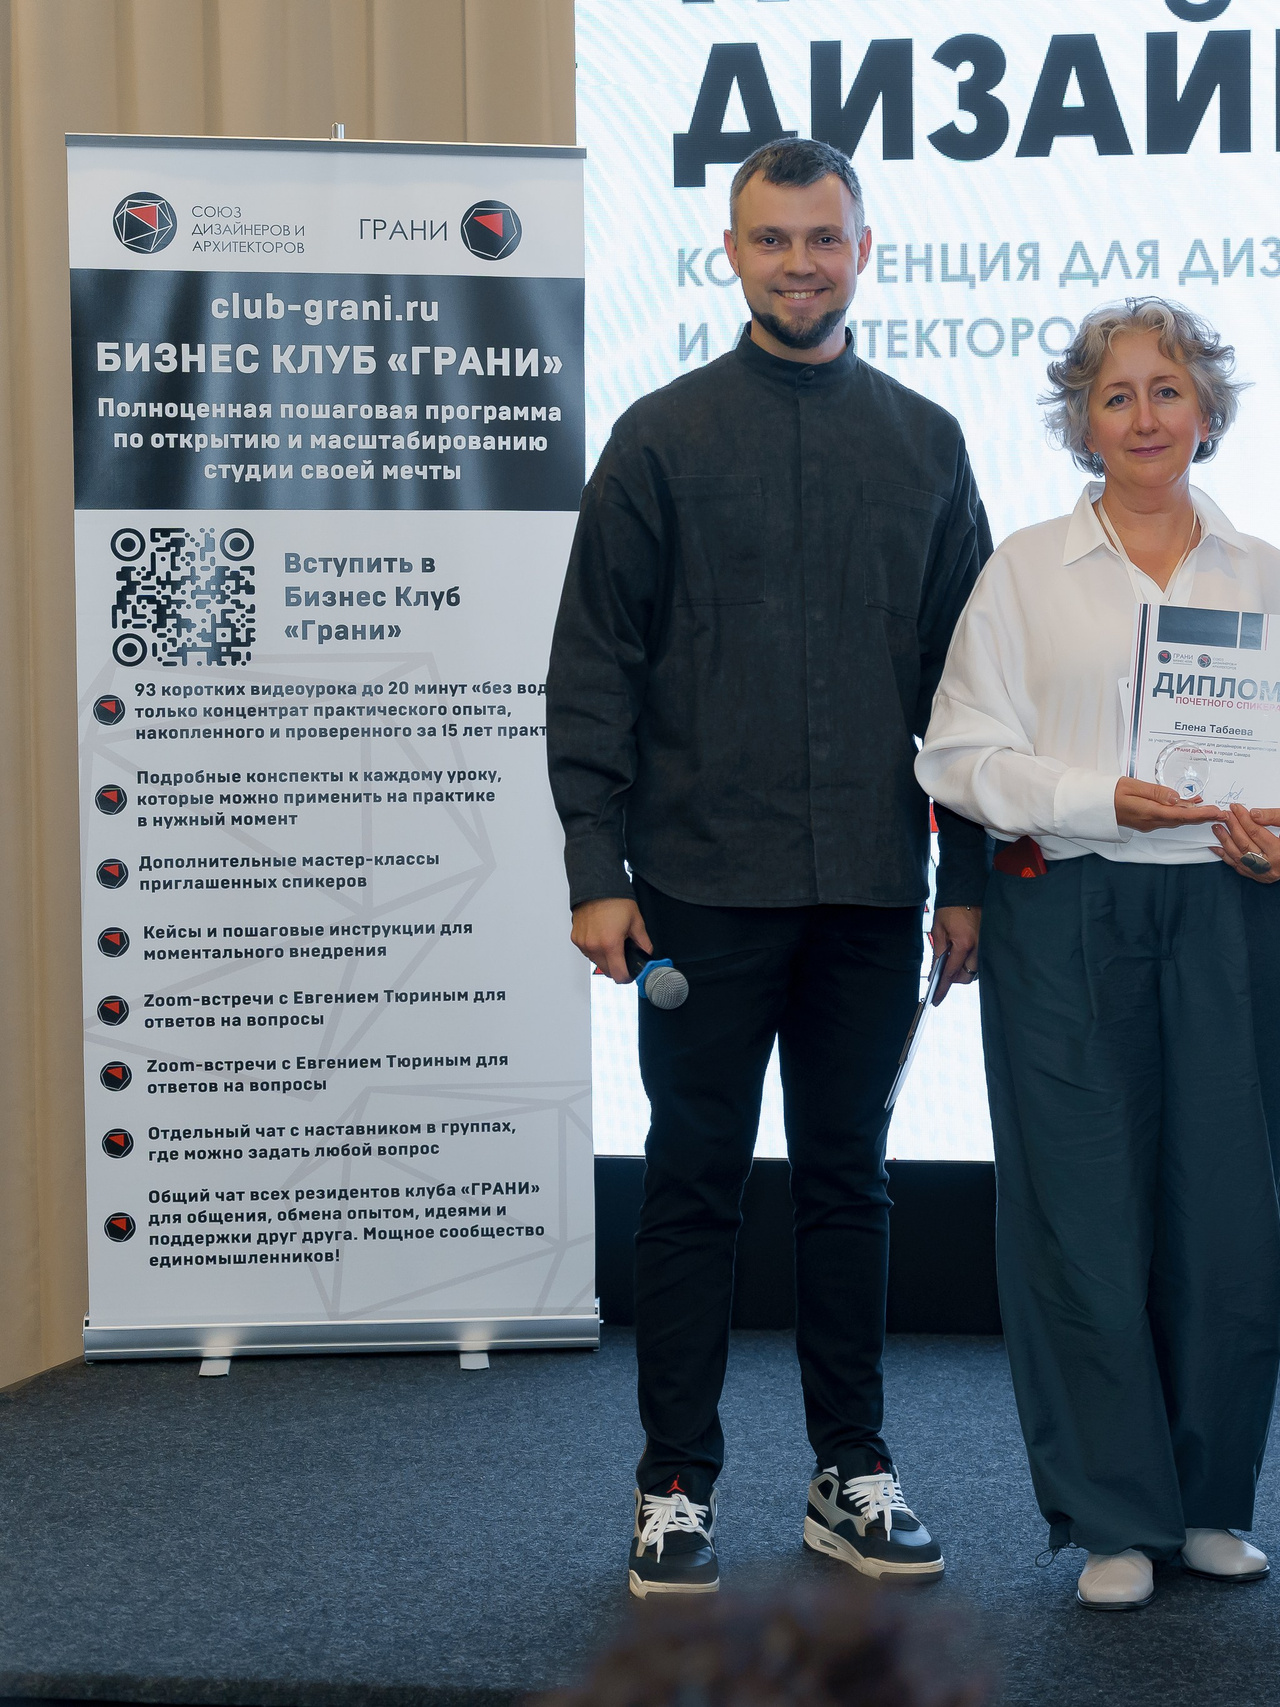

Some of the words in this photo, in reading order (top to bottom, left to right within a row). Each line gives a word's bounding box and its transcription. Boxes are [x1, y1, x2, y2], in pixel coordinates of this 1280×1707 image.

[192, 206, 241, 218] СОЮЗ
[192, 222, 290, 236] ДИЗАЙНЕРОВ
[295, 225, 304, 236] И
[360, 219, 447, 241] ГРАНИ
[192, 241, 304, 253] АРХИТЕКТОРОВ
[677, 241, 1042, 292] КОЕНЦИЯ
[1059, 237, 1158, 287] ДЛЯ
[211, 293, 439, 325] club-grani.ru
[679, 323, 710, 361] И
[97, 342, 259, 373] БИЗНЕС
[273, 345, 376, 374] КЛУБ
[388, 347, 562, 377] «ГРАНИ»
[98, 398, 272, 421] Полноценная
[281, 403, 417, 424] пошаговая
[426, 405, 561, 424] программа
[114, 433, 143, 448] по
[151, 432, 280, 453] открытию
[288, 434, 301, 448] и
[311, 431, 547, 453] масштабированию
[204, 462, 294, 482] студии
[302, 460, 374, 479] своей
[383, 465, 460, 480] мечты
[285, 553, 413, 577] Вступить
[422, 558, 435, 573] в
[285, 587, 386, 607] Бизнес
[396, 586, 460, 611] Клуб
[285, 620, 401, 644] «Грани»
[135, 683, 156, 696] 93
[162, 686, 245, 698] коротких
[251, 685, 356, 698] видеоурока
[362, 684, 383, 697] до
[389, 681, 408, 694] 20
[415, 684, 467, 697] минут
[472, 681, 512, 694] «без
[517, 683, 546, 698] вод
[1176, 696, 1234, 708] ПОЧЕТНОГО
[135, 707, 197, 718] только
[203, 706, 308, 719] концентрат
[314, 705, 447, 719] практического
[452, 705, 511, 717] опыта,
[136, 728, 264, 739] накопленного
[270, 728, 280, 738] и
[286, 727, 411, 740] проверенного
[417, 727, 436, 737] за
[442, 724, 457, 736] 15
[463, 727, 492, 736] лет
[497, 725, 546, 742] практ
[1174, 722, 1206, 732] Елена
[1210, 724, 1253, 736] Табаева
[137, 770, 241, 786] Подробные
[247, 772, 343, 782] конспекты
[349, 772, 358, 781] к
[364, 771, 443, 783] каждому
[447, 771, 501, 783] уроку,
[138, 794, 214, 807] которые
[220, 794, 278, 804] можно
[284, 793, 382, 806] применить
[387, 792, 407, 802] на
[413, 792, 495, 804] практике
[138, 817, 147, 827] в
[153, 812, 225, 829] нужный
[231, 815, 297, 825] момент
[139, 856, 296, 871] Дополнительные
[303, 855, 439, 868] мастер-классы
[140, 878, 277, 893] приглашенных
[282, 877, 367, 890] спикеров
[144, 925, 201, 939] Кейсы
[207, 928, 217, 937] и
[223, 926, 324, 937] пошаговые
[330, 924, 435, 938] инструкции
[440, 924, 472, 936] для
[144, 948, 284, 960] моментального
[290, 946, 386, 959] внедрения
[144, 994, 273, 1008] Zoom-встречи
[279, 995, 288, 1004] с
[294, 991, 378, 1004] Евгением
[384, 990, 468, 1005] Тюриным
[474, 991, 505, 1003] для
[145, 1017, 215, 1028] ответов
[221, 1017, 241, 1026] на
[247, 1015, 323, 1028] вопросы
[147, 1060, 276, 1073] Zoom-встречи
[282, 1060, 291, 1070] с
[297, 1057, 381, 1069] Евгением
[386, 1055, 470, 1070] Тюриным
[476, 1056, 508, 1068] для
[148, 1083, 218, 1094] ответов
[224, 1082, 244, 1092] на
[250, 1080, 326, 1093] вопросы
[149, 1124, 250, 1141] Отдельный
[256, 1127, 285, 1137] чат
[290, 1127, 299, 1136] с
[305, 1124, 421, 1136] наставником
[427, 1124, 436, 1133] в
[442, 1122, 515, 1135] группах,
[149, 1150, 178, 1162] где
[185, 1149, 243, 1160] можно
[248, 1148, 310, 1160] задать
[315, 1143, 371, 1157] любой
[378, 1144, 439, 1157] вопрос
[149, 1189, 209, 1204] Общий
[215, 1191, 245, 1201] чат
[250, 1190, 290, 1201] всех
[295, 1188, 400, 1202] резидентов
[406, 1183, 455, 1199] клуба
[461, 1182, 539, 1195] «ГРАНИ»
[149, 1214, 181, 1226] для
[187, 1210, 272, 1224] общения,
[278, 1208, 341, 1221] обмена
[348, 1208, 419, 1220] опытом,
[425, 1206, 490, 1219] идеями
[497, 1206, 506, 1216] и
[150, 1233, 251, 1247] поддержки
[257, 1232, 297, 1245] друг
[302, 1231, 357, 1244] друга.
[364, 1227, 434, 1241] Мощное
[440, 1225, 544, 1239] сообщество
[150, 1249, 339, 1268] единомышленников!
